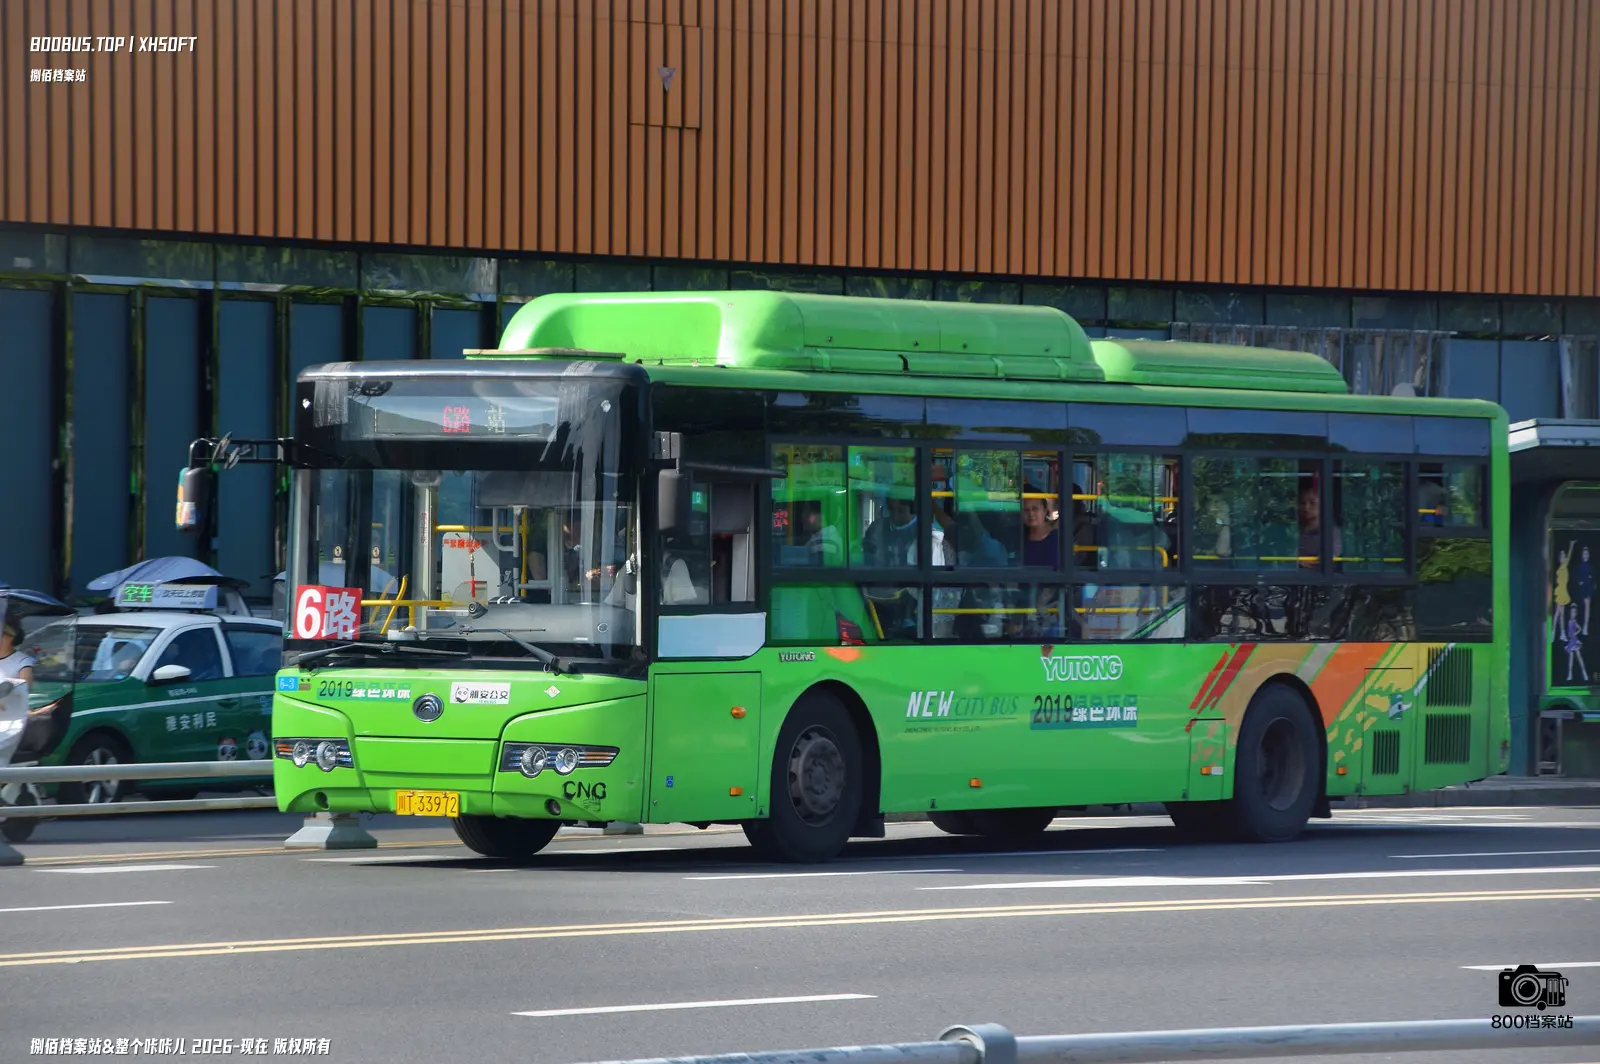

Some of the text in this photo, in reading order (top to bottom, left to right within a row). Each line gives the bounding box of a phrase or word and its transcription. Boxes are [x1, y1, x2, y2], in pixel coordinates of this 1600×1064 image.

[122, 584, 154, 602] 空车
[296, 588, 358, 640] 6路
[778, 651, 815, 662] YUTONG
[1040, 655, 1123, 682] YUTONG
[906, 690, 1019, 718] NEW CITY BUS
[165, 711, 217, 732] 雅安利民
[562, 780, 607, 800] CNG
